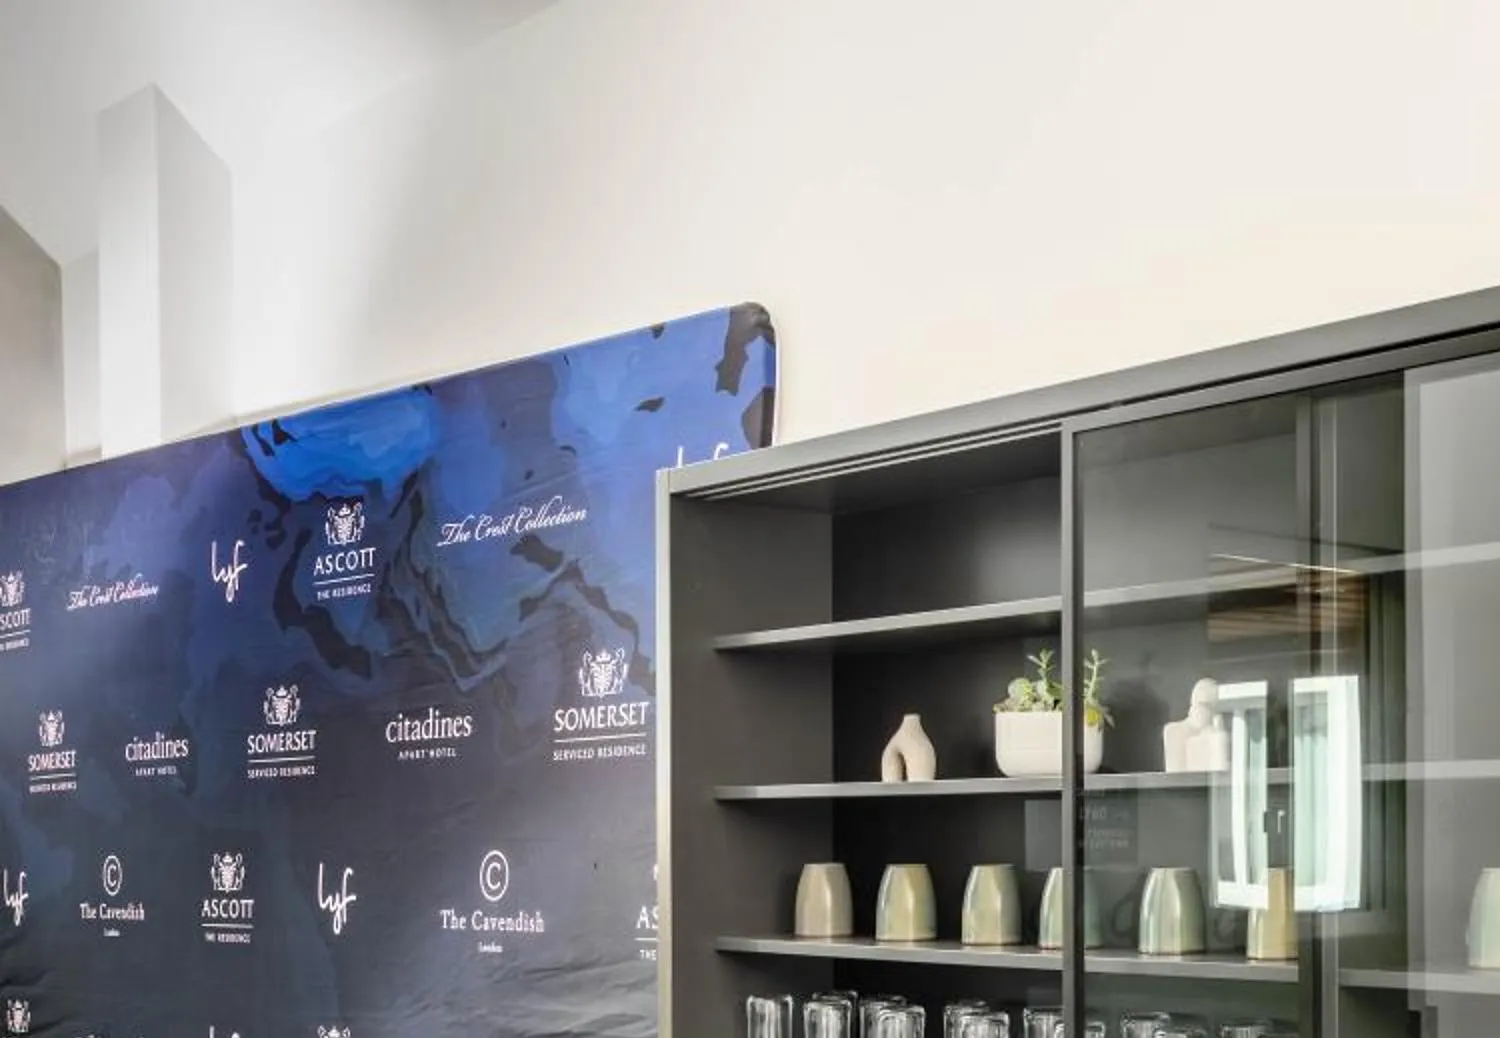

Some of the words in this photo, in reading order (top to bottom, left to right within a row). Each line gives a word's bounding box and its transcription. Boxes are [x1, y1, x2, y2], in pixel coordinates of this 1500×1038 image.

[436, 514, 475, 547] The
[514, 496, 588, 534] Collection
[211, 540, 248, 603] lyf
[313, 547, 376, 576] ASCOTT
[0, 608, 31, 630] SCOTT
[385, 707, 473, 743] citadines
[553, 701, 650, 731] SOMERSET
[125, 731, 189, 761] citadines
[247, 730, 317, 754] SOMERSET
[28, 750, 77, 772] SOMERSET
[80, 902, 97, 919] The
[99, 902, 145, 921] Cavendish
[201, 899, 254, 918] ASCOTT
[318, 862, 356, 935] lyf
[440, 909, 467, 930] The
[471, 910, 545, 933] Cavendish
